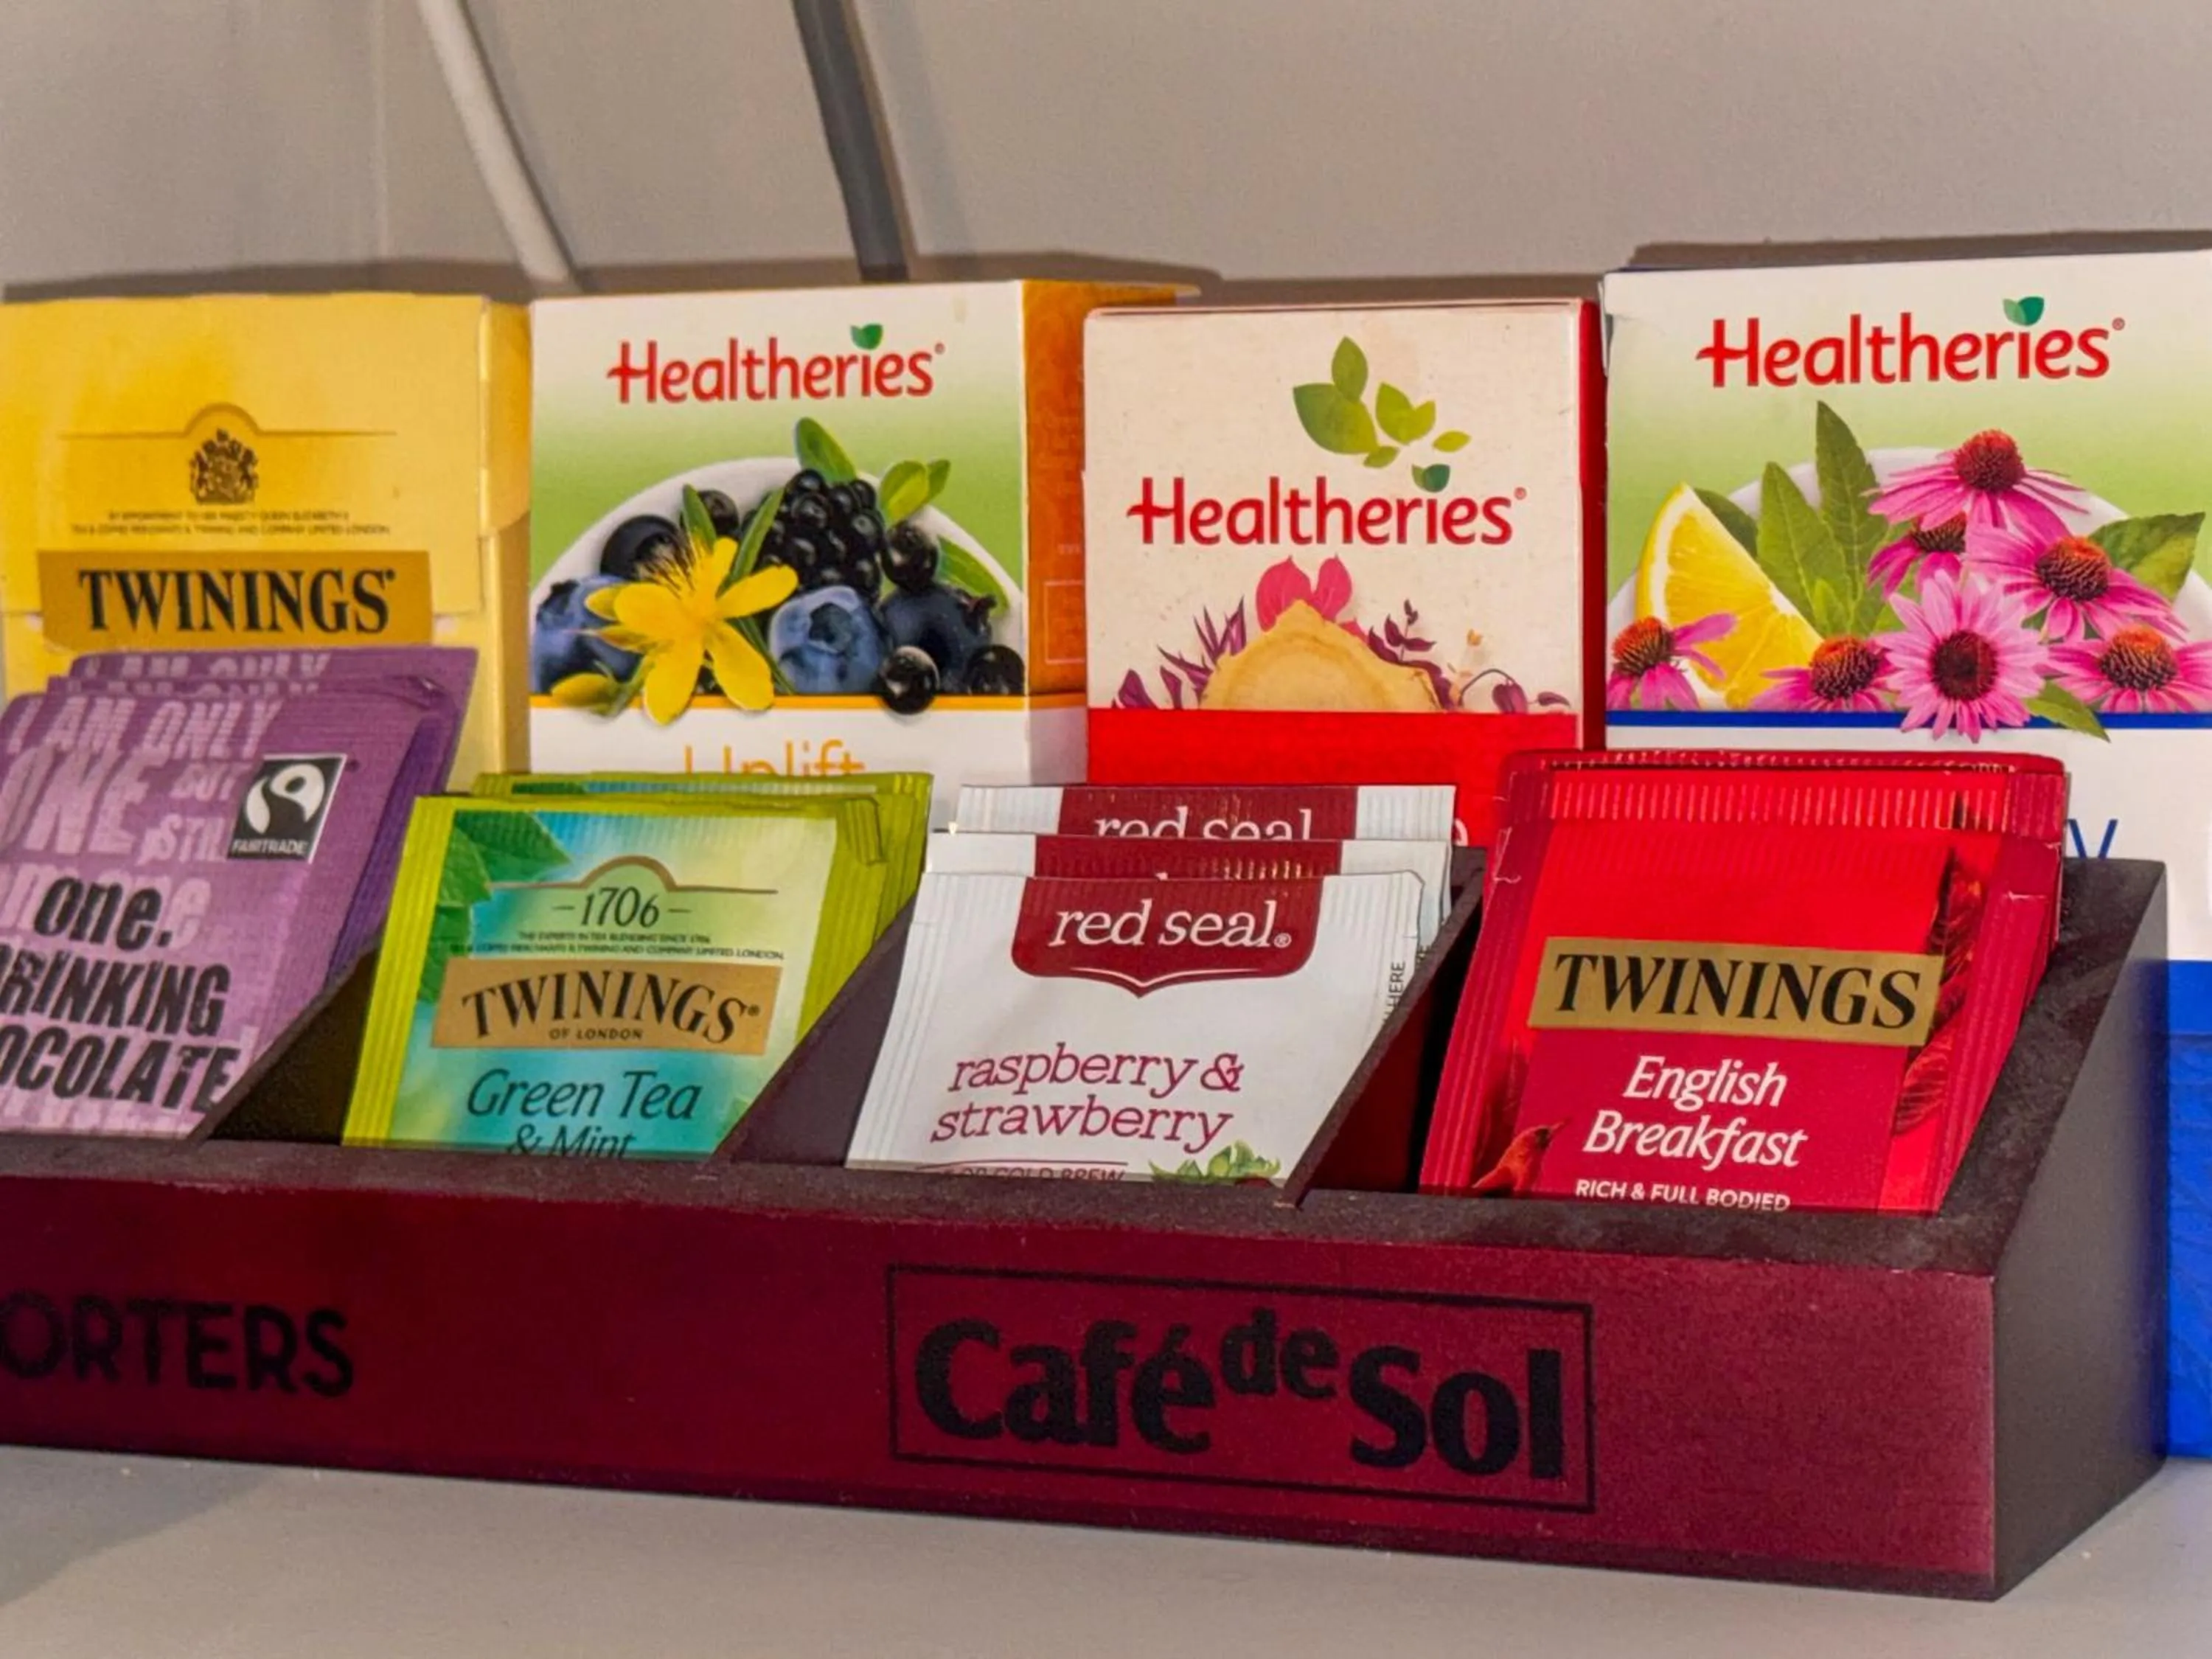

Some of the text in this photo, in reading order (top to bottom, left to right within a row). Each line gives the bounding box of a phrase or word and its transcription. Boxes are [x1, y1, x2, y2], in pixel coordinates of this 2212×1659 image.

[607, 337, 935, 403] Healtheries
[1697, 312, 2110, 388] Healtheries
[1127, 476, 1512, 545] Healtheries
[79, 568, 392, 633] TWININGS
[684, 739, 866, 776] Ulift
[232, 838, 310, 856] FAIRTRADE
[580, 886, 661, 928] 1706
[1048, 900, 1273, 948] red seal
[462, 969, 749, 1045] TWININGS
[1554, 953, 1921, 1030] TWININGS
[549, 1027, 643, 1040] OF LONDON
[467, 1068, 703, 1120] Green Tea
[947, 1042, 1245, 1099] raspberry &
[1624, 1055, 1788, 1112] English
[507, 1123, 636, 1158] & Mint
[931, 1096, 1234, 1154] strawberry
[1583, 1109, 1809, 1172] Breakfast
[1575, 1179, 1792, 1212] RICH & FULL BODIED
[914, 1307, 1565, 1480] Café de Sol
